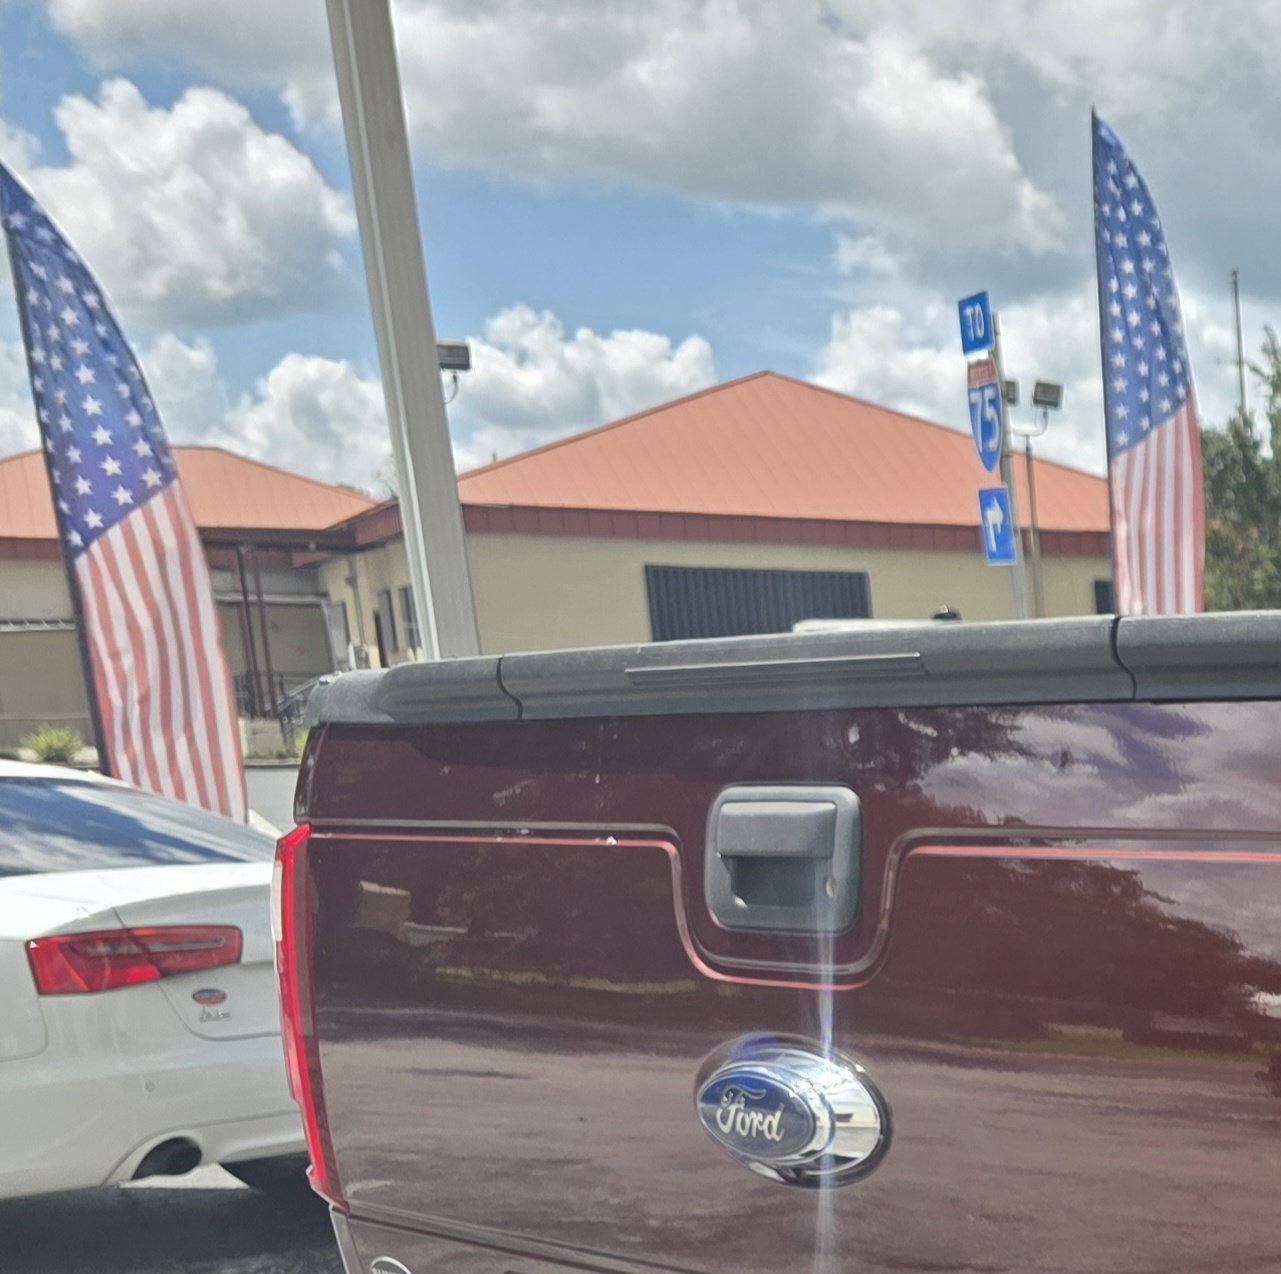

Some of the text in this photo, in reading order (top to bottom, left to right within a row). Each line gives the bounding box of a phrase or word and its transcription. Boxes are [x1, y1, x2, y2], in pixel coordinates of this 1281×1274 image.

[963, 302, 985, 342] TO
[969, 387, 1000, 453] 75
[715, 1083, 785, 1142] Ford
